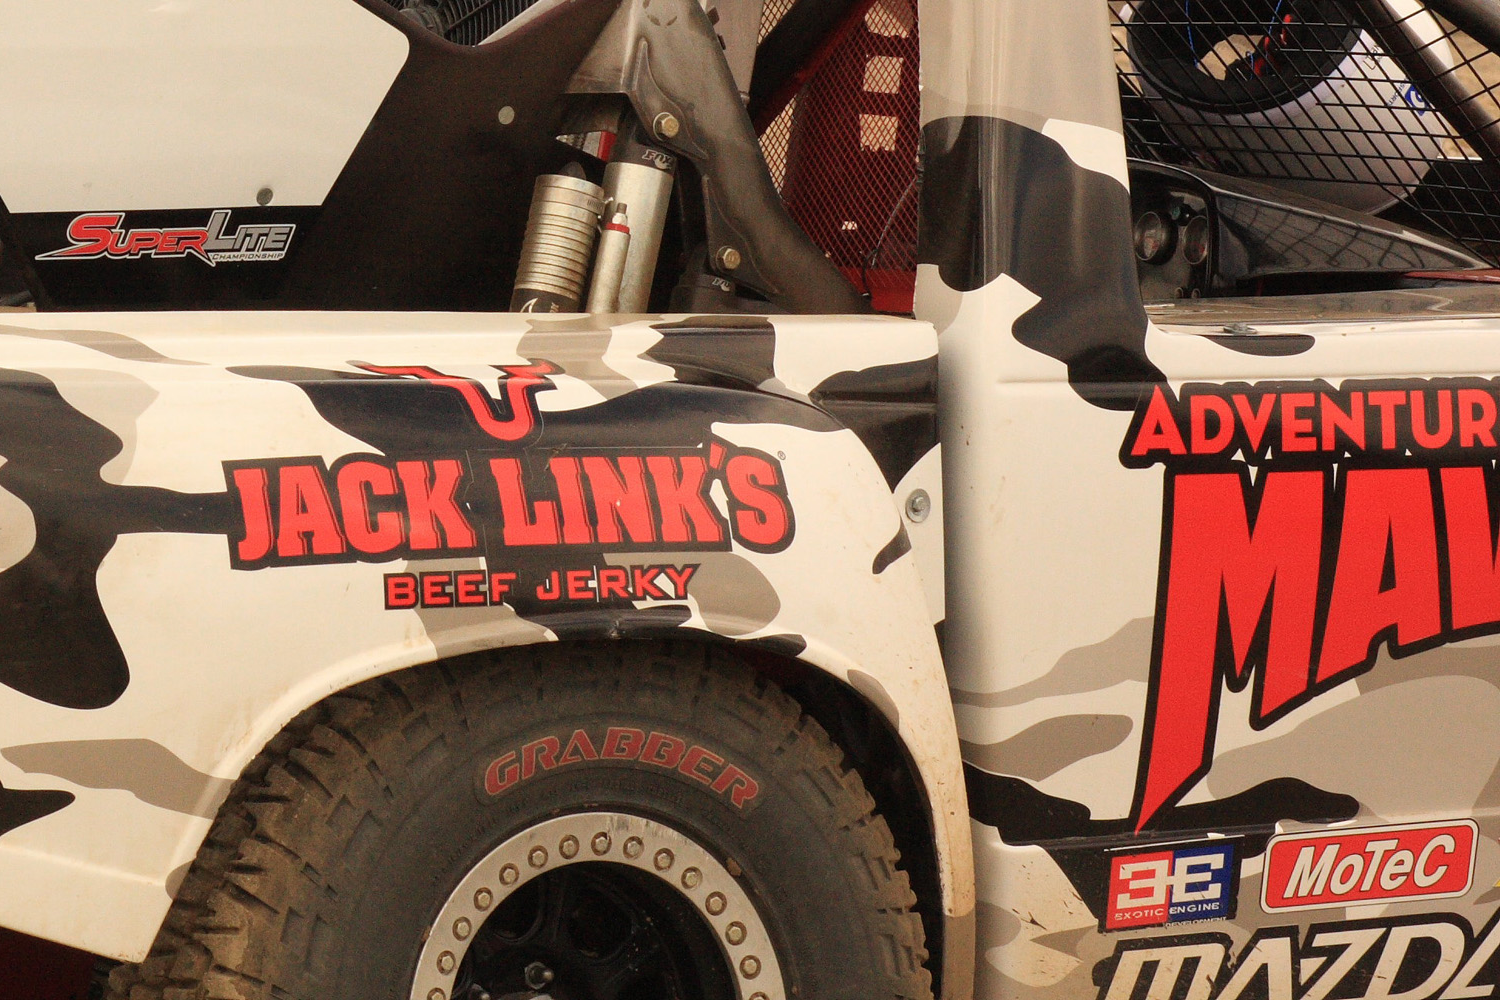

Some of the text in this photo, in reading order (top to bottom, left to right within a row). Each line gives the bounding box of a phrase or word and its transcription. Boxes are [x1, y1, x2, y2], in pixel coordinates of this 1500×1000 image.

[211, 252, 284, 261] CHAMPIONSHIP
[1130, 384, 1498, 456] ADVENTUR
[233, 443, 790, 562] JACK LINK'S
[386, 564, 699, 608] BEEF JERKY
[484, 726, 759, 809] GRABBER
[1283, 834, 1457, 899] MoTeC
[1114, 902, 1220, 921] EXOTIC ENGINE
